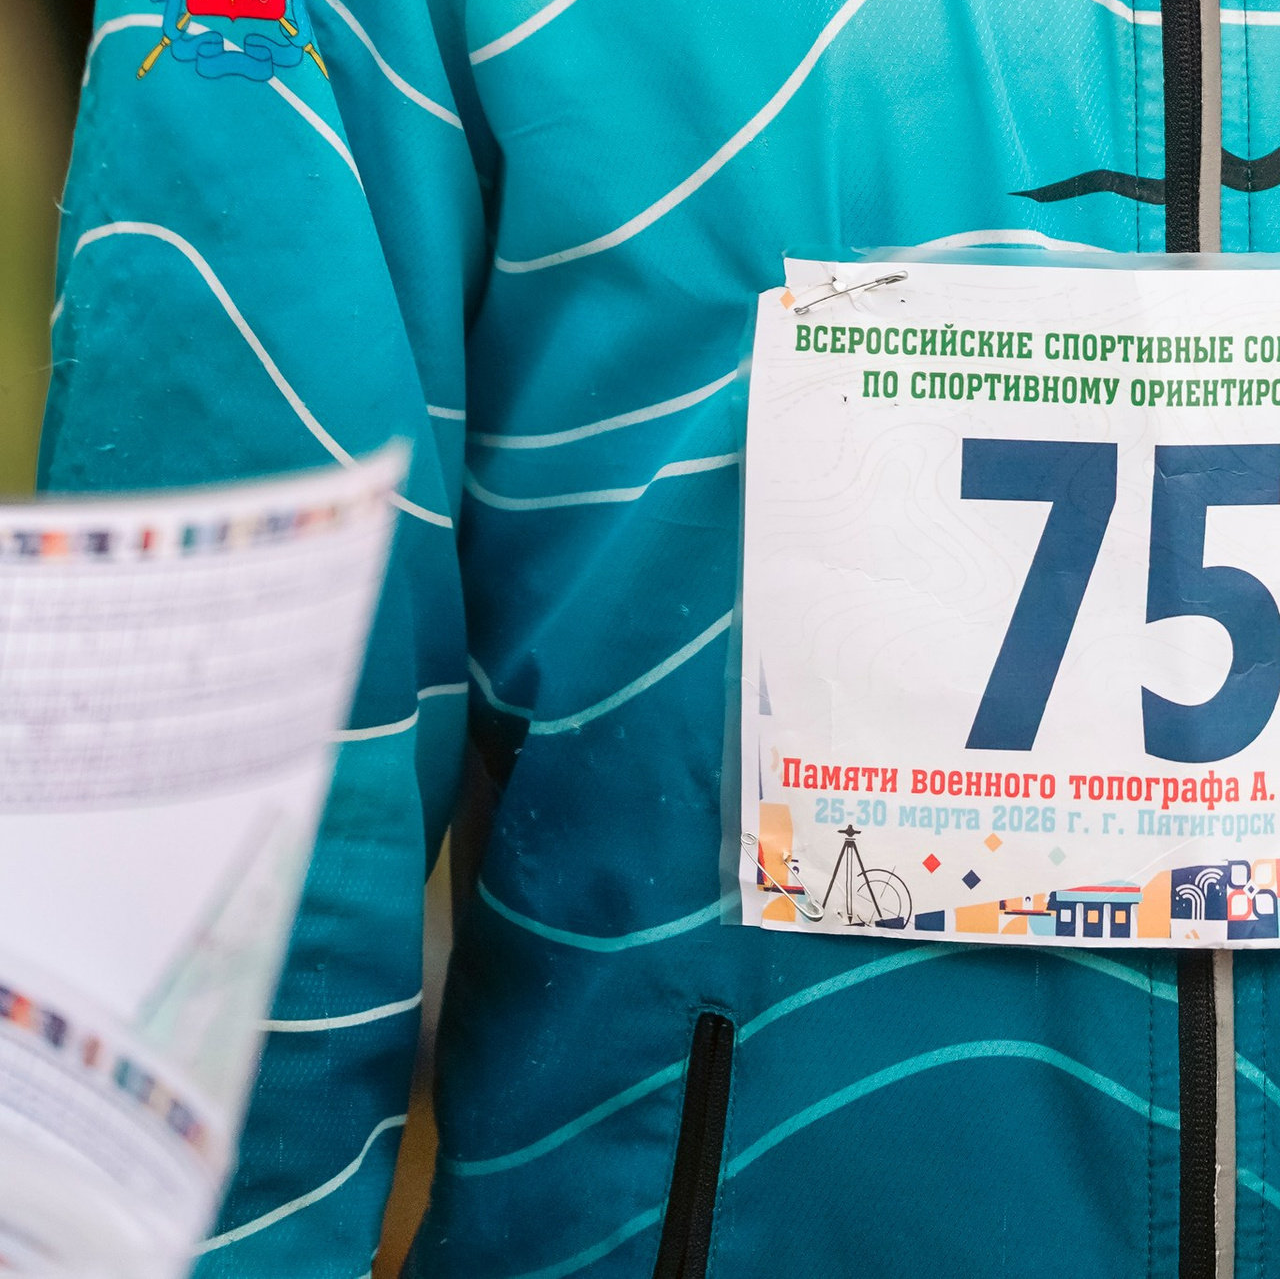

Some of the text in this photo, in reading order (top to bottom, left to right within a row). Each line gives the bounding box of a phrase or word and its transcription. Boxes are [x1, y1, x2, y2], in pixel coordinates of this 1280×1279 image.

[795, 323, 1033, 359] ВСЕРОССИЙСКИЕ
[1044, 332, 1233, 363] СПОРТИВНЫЕ
[862, 370, 899, 399] ПО
[911, 371, 1120, 406] СПОРТИВНОМУ
[782, 757, 899, 793] Памяти
[911, 768, 1056, 799] военного
[1069, 769, 1238, 810] топографа
[1250, 771, 1275, 801] А.
[814, 797, 1276, 842] 25-30 марта 2026 г. г. Пятигорск
